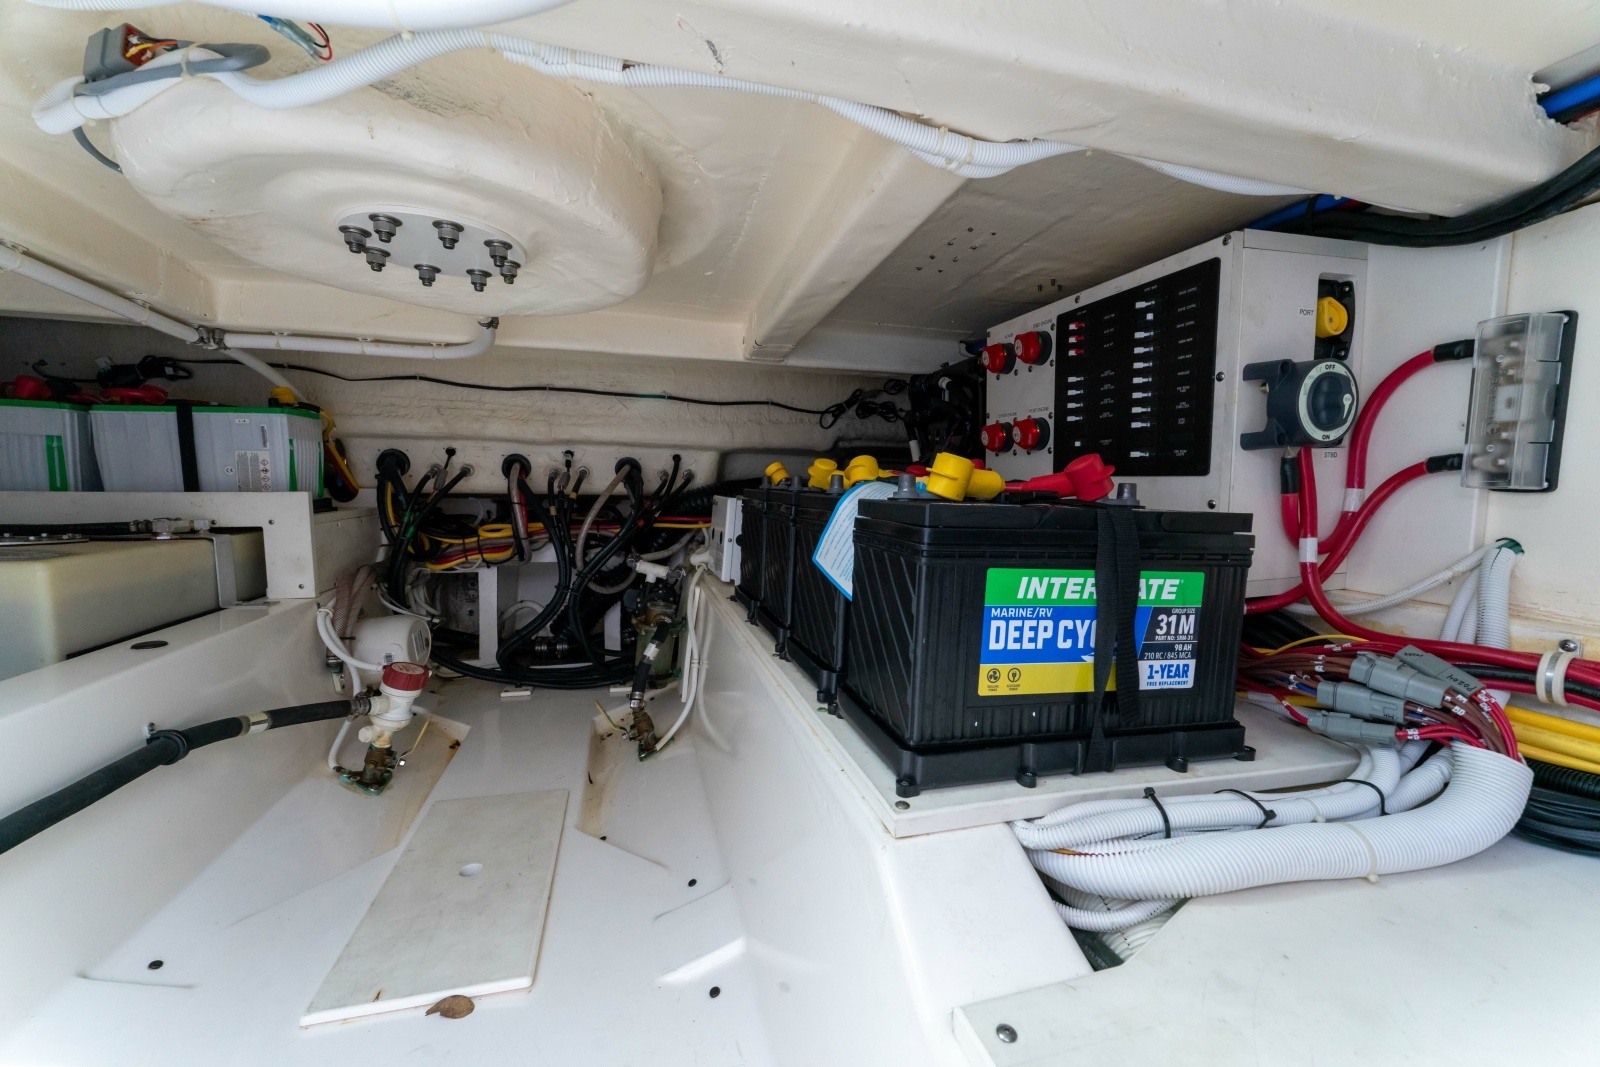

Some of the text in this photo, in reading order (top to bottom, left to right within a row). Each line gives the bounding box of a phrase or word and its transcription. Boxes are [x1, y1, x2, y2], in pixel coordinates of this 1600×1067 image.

[1017, 576, 1180, 600] INTERATE
[991, 607, 1053, 618] MARINE/RV
[1156, 614, 1196, 634] 31M
[989, 620, 1054, 650] DEEP
[1147, 664, 1190, 679] 1-YEAR
